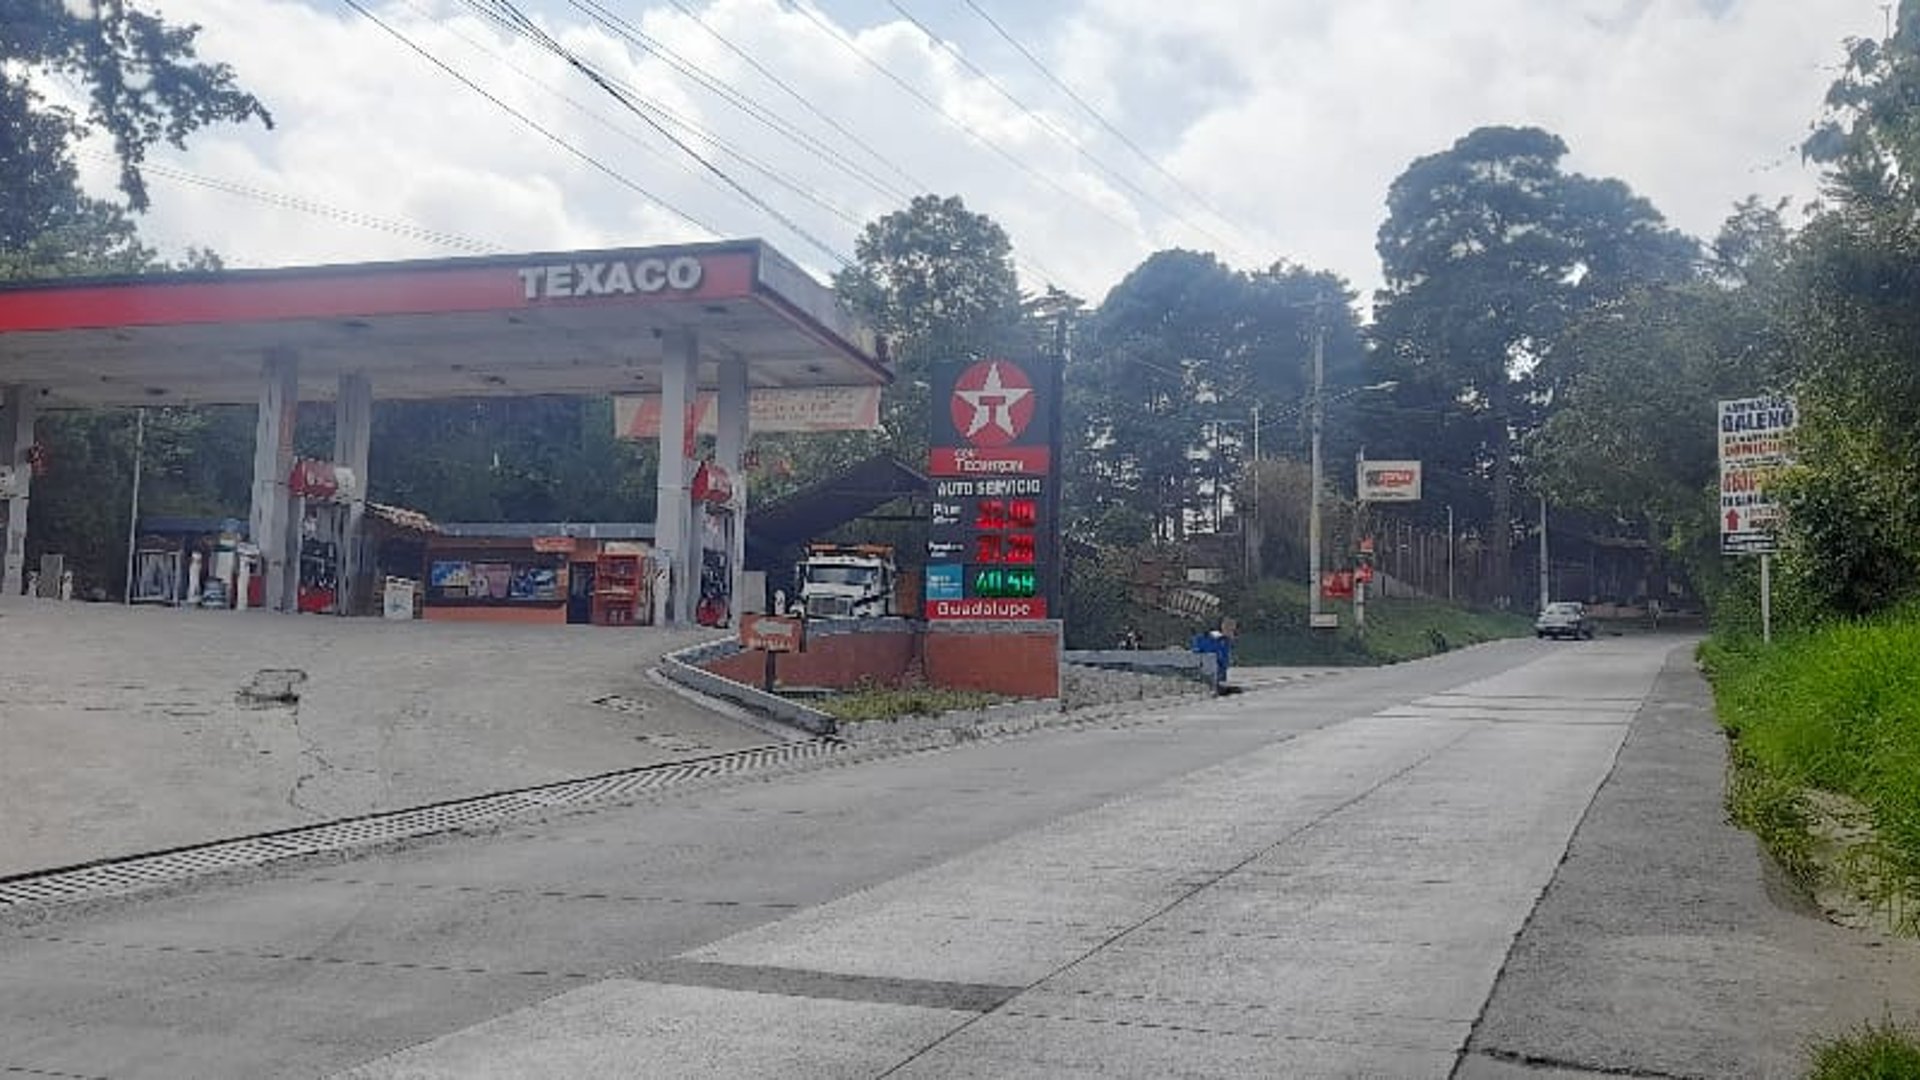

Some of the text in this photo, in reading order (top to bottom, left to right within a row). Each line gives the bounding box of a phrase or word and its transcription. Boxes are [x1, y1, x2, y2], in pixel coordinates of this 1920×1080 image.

[518, 256, 701, 298] TEXACO
[937, 479, 1040, 497] AUTO SERVICIO
[937, 602, 1031, 617] Guadalupe
